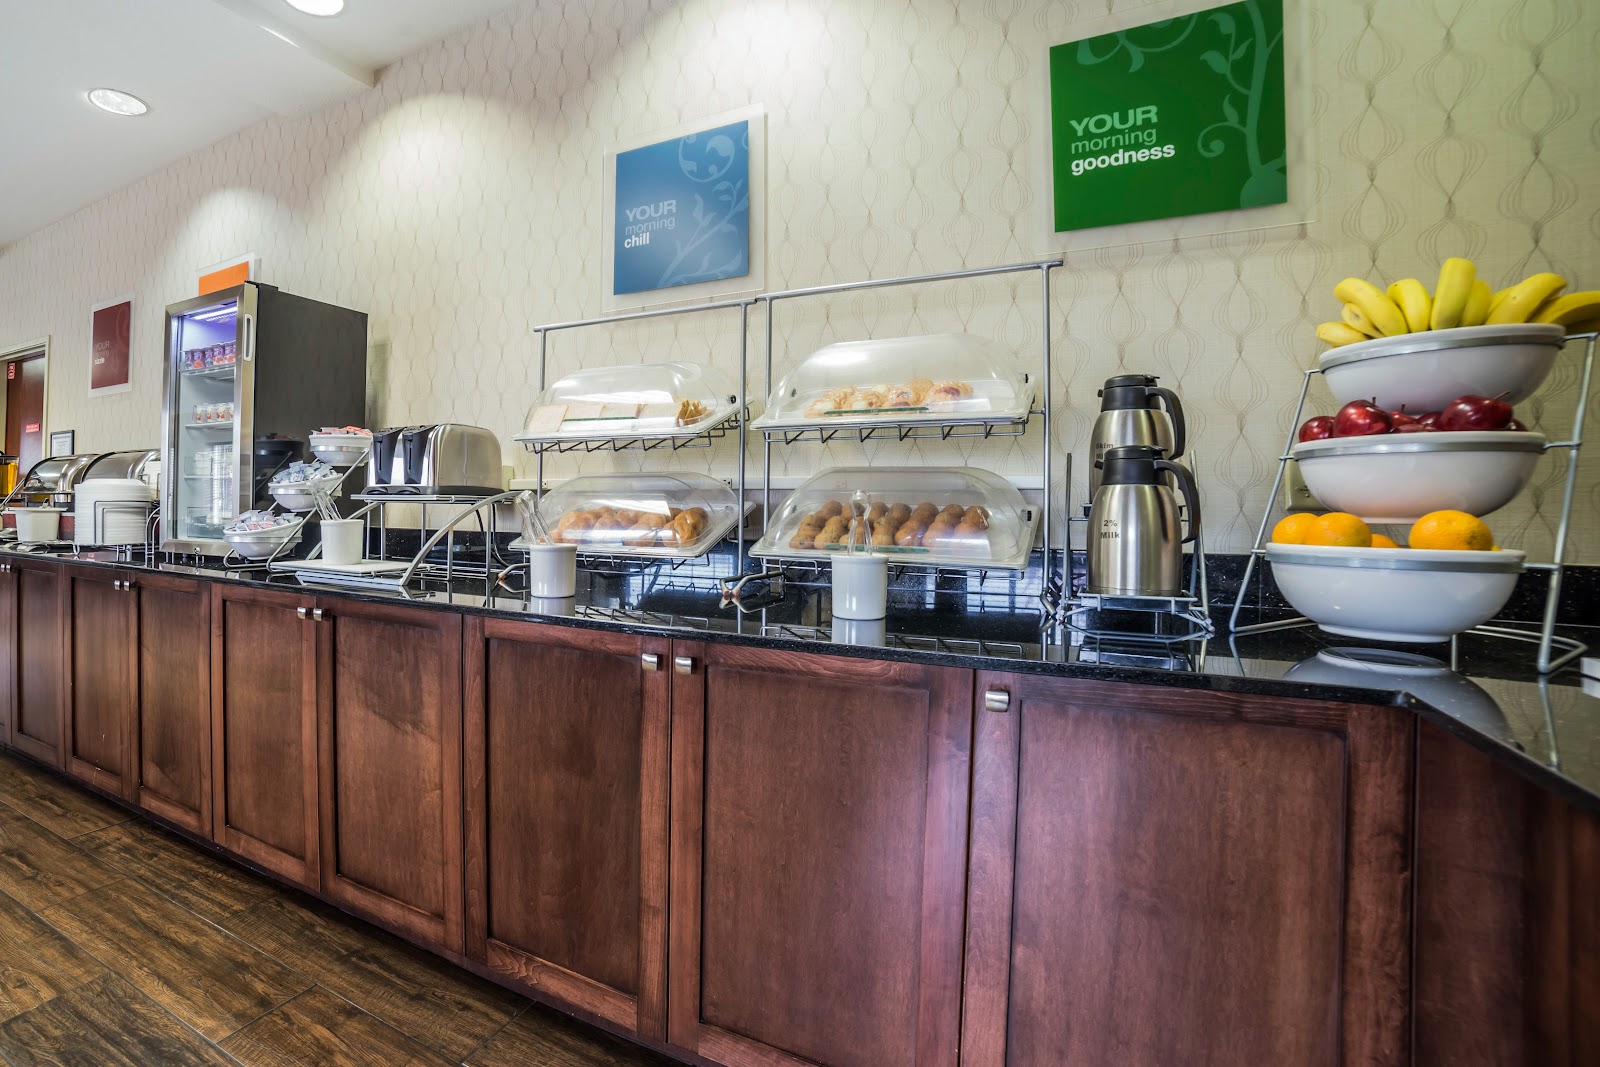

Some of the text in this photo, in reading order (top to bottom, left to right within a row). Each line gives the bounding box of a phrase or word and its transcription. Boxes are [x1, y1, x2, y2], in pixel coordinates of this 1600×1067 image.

[1069, 105, 1158, 137] YOUR
[1071, 128, 1157, 154] morning
[1071, 144, 1175, 176] goodness
[625, 199, 676, 222] YOUR
[625, 217, 675, 235] morning
[624, 232, 650, 249] chill
[1103, 519, 1118, 527] 2%
